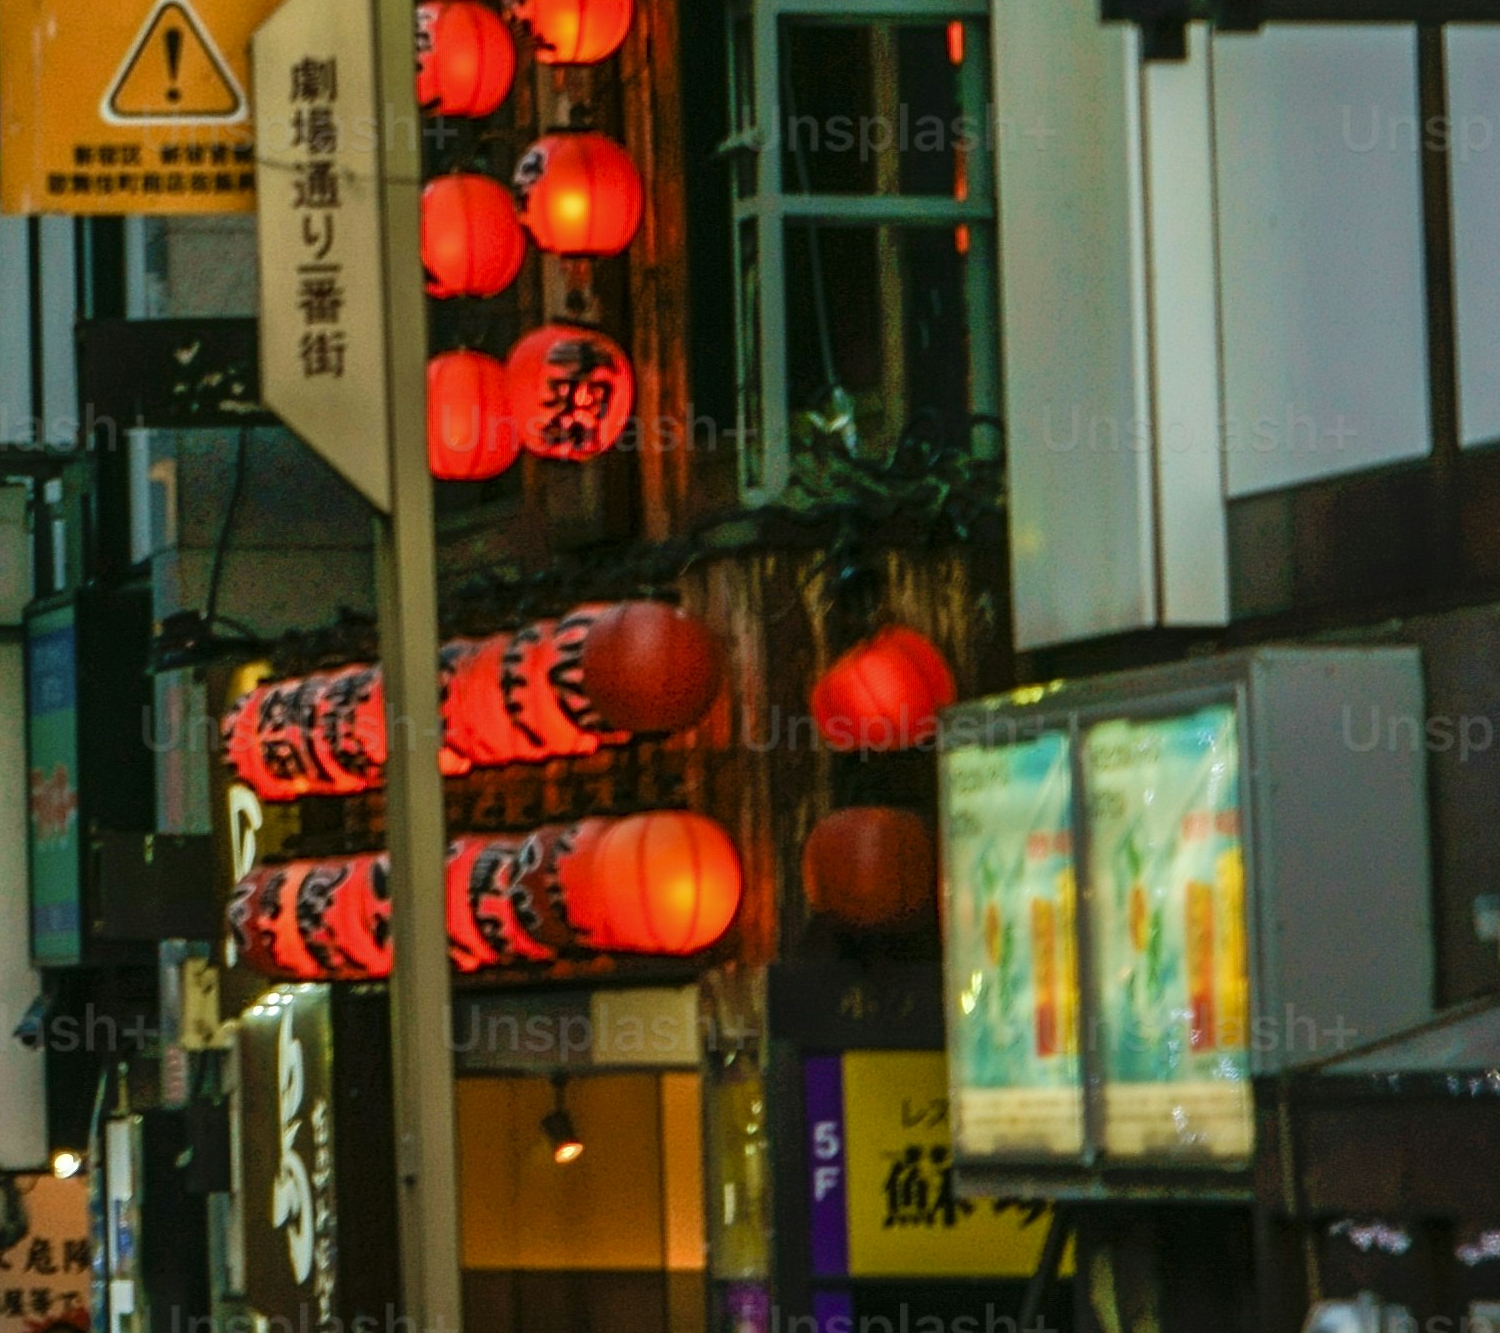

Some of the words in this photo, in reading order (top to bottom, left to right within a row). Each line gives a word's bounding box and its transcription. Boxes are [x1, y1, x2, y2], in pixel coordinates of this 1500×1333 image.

[288, 55, 348, 381] 劇場通り一番街
[813, 1123, 839, 1201] 5F
